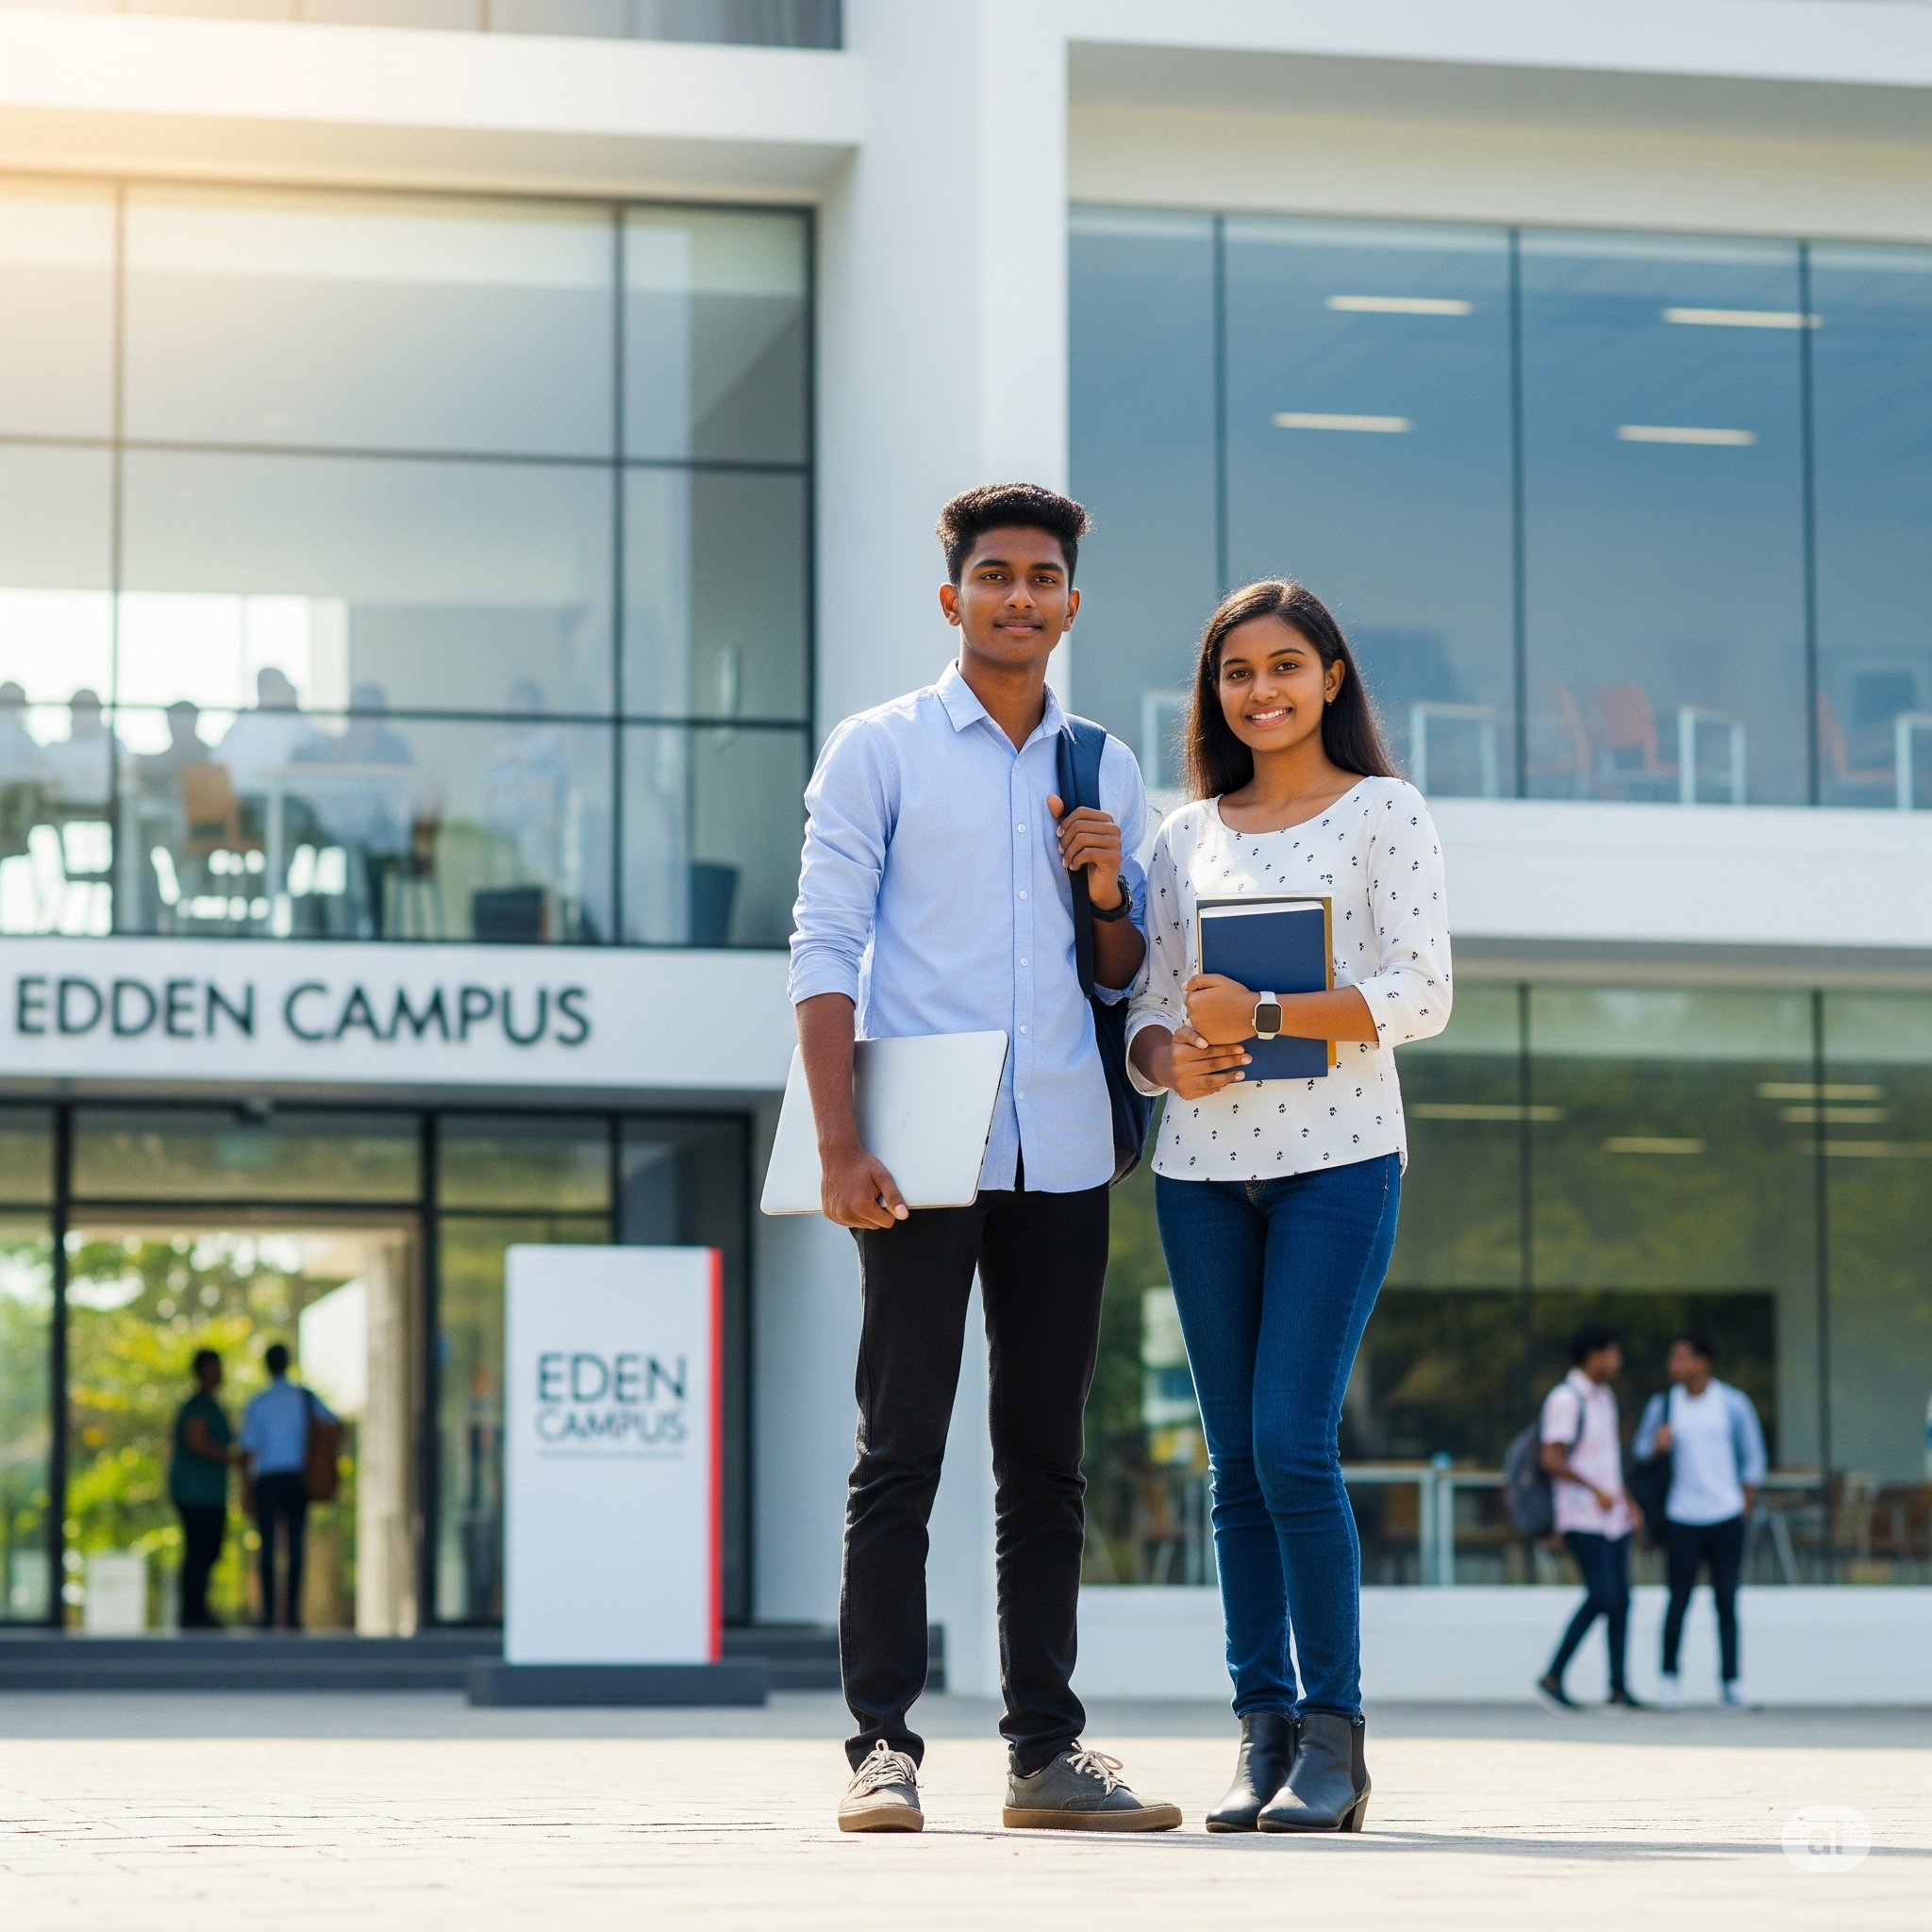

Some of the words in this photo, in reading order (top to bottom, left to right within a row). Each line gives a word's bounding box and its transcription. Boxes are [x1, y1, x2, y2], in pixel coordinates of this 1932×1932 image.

[16, 975, 256, 1038] EDDEN
[284, 980, 592, 1047] CAMPUS
[538, 1351, 687, 1403] EDEN
[535, 1407, 688, 1444] CAMPUS
